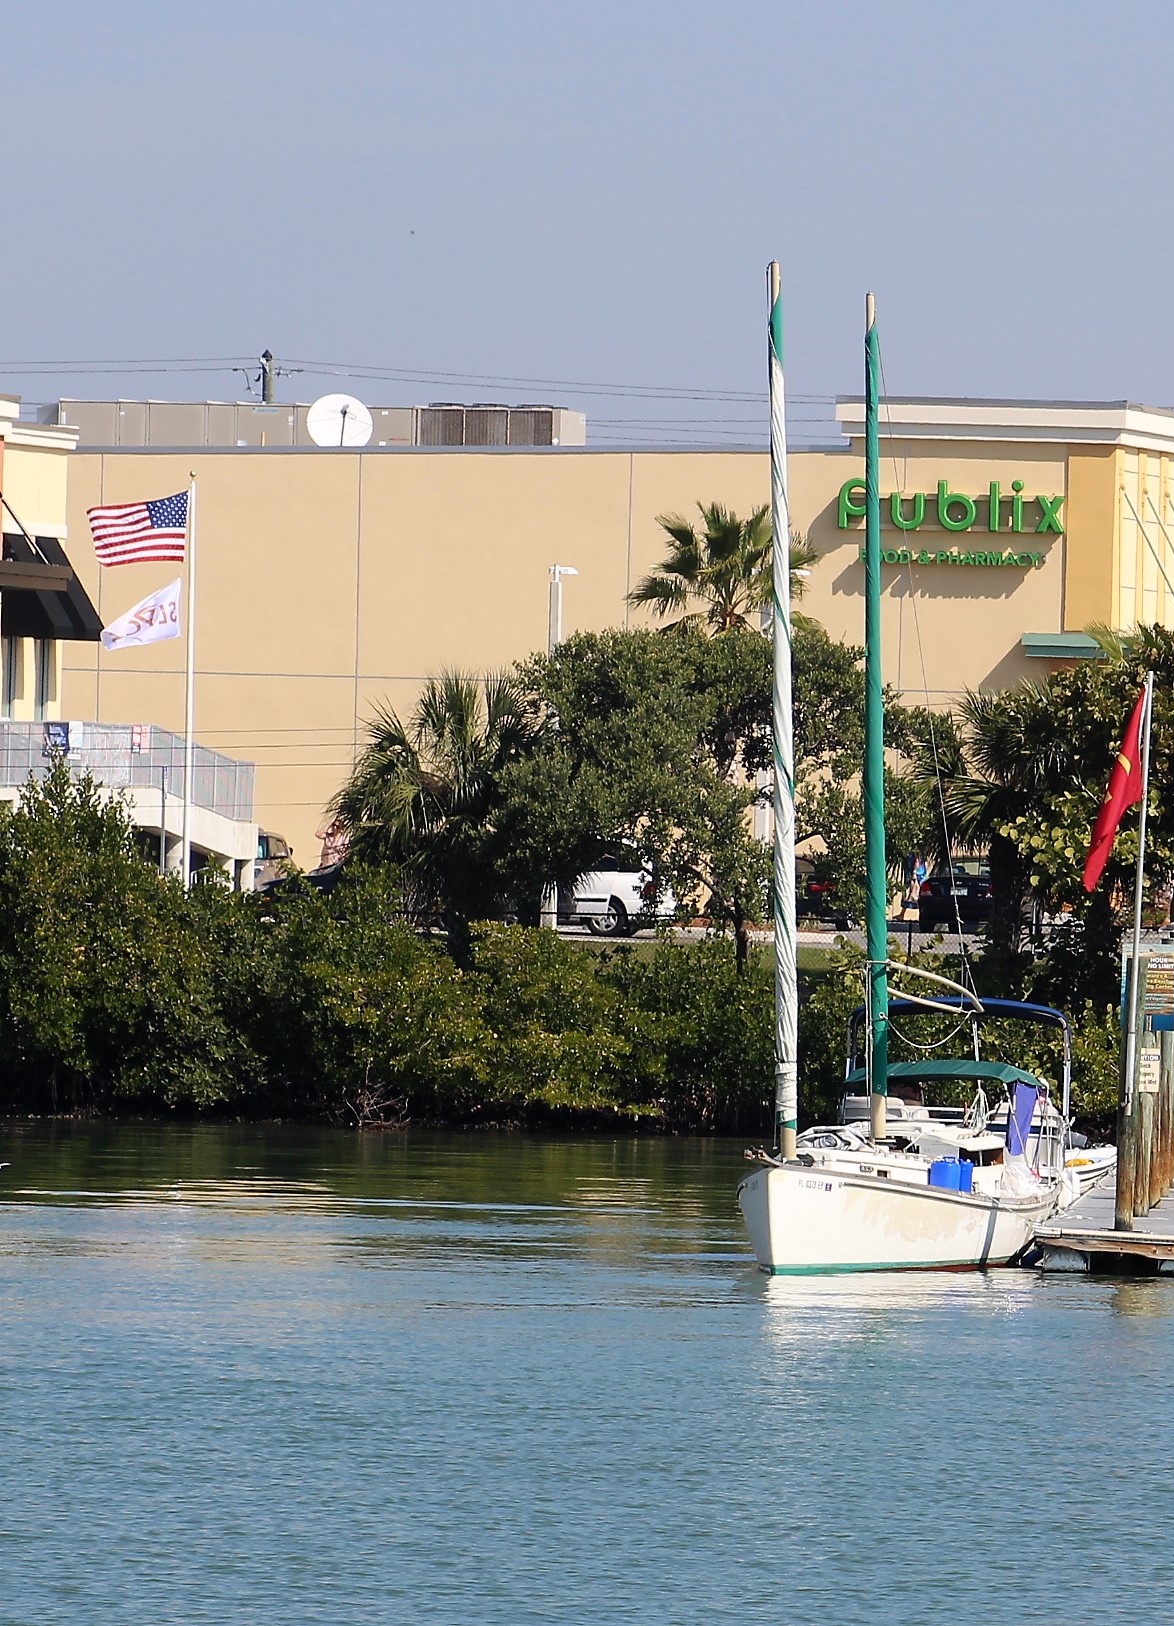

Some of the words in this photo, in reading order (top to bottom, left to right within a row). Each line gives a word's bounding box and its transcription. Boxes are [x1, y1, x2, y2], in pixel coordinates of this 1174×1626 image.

[838, 478, 1066, 533] Publix
[860, 549, 912, 565] FOD
[918, 551, 931, 566] &
[937, 551, 1041, 568] PHARMACY
